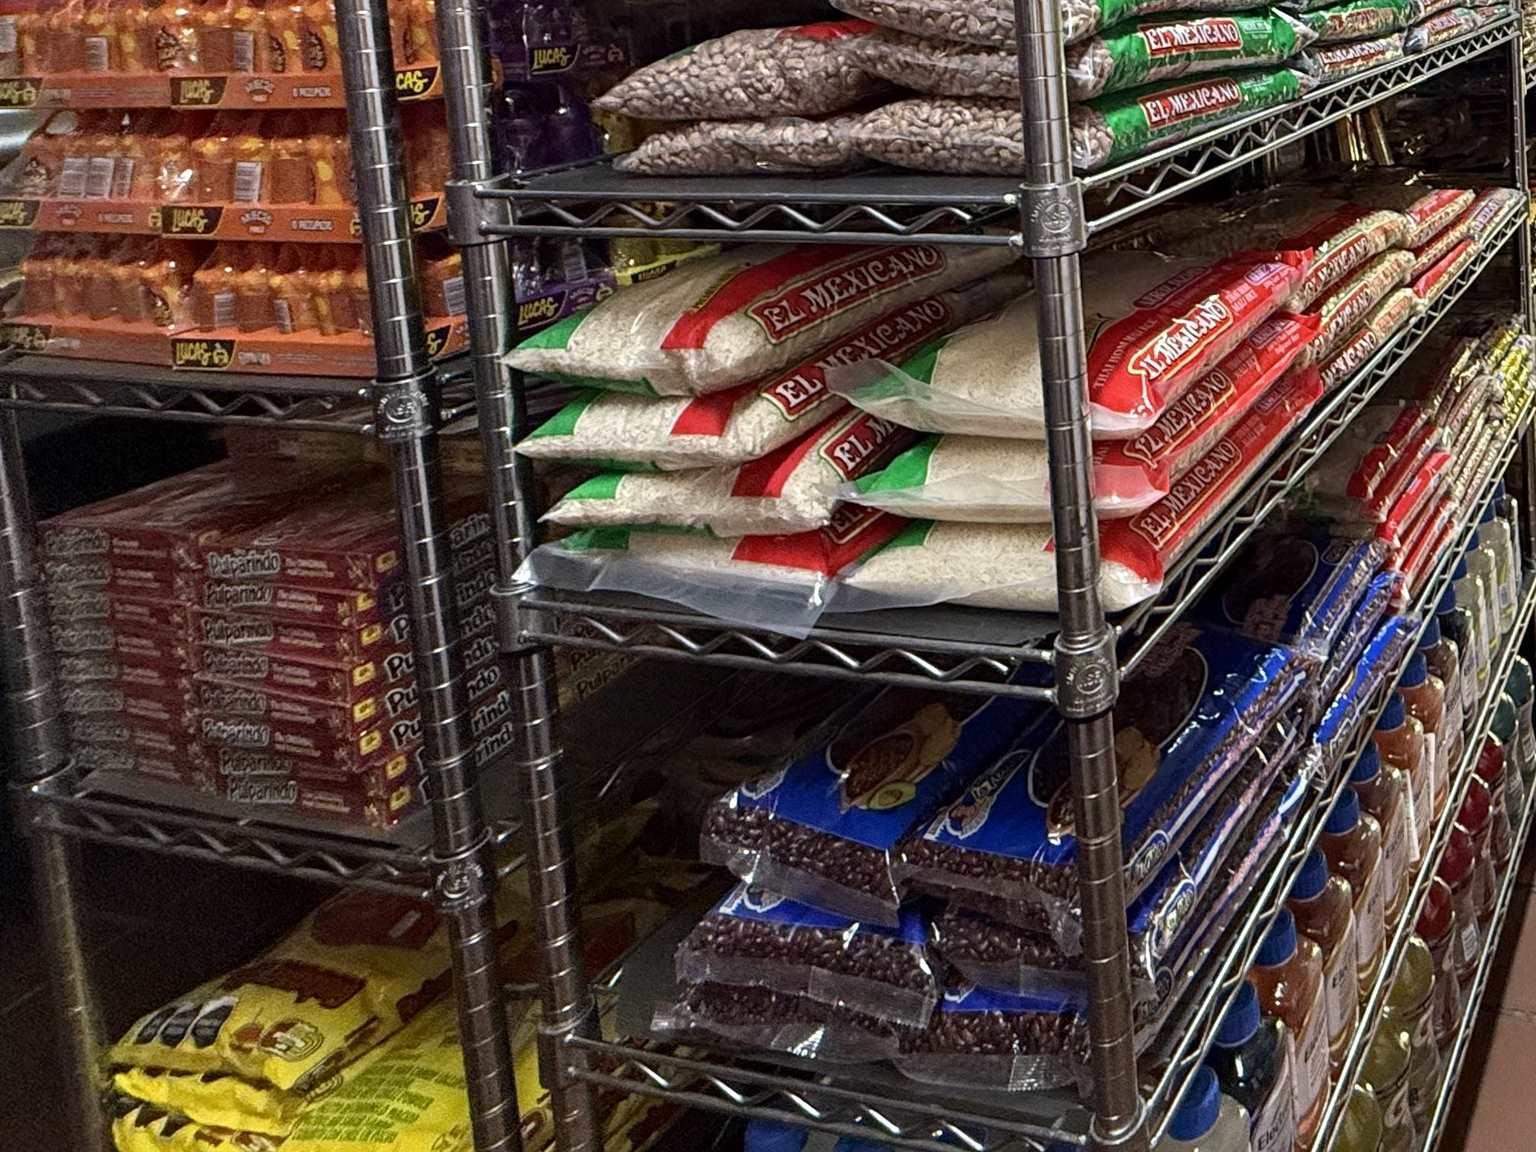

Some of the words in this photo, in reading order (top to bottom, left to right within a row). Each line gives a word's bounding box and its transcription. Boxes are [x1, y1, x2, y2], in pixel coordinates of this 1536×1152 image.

[1145, 26, 1169, 50] EL
[1173, 21, 1240, 49] MEXICANO
[395, 69, 429, 94] CAS
[1147, 101, 1170, 123] EL
[1171, 80, 1239, 116] MEXICANO
[764, 298, 807, 332] EL
[800, 245, 938, 315] MEXICANO
[776, 374, 823, 409] EL
[834, 430, 872, 472] EL
[1141, 513, 1172, 539] EL
[1170, 440, 1236, 510] MEXICANO
[207, 551, 281, 577] Pulparindo
